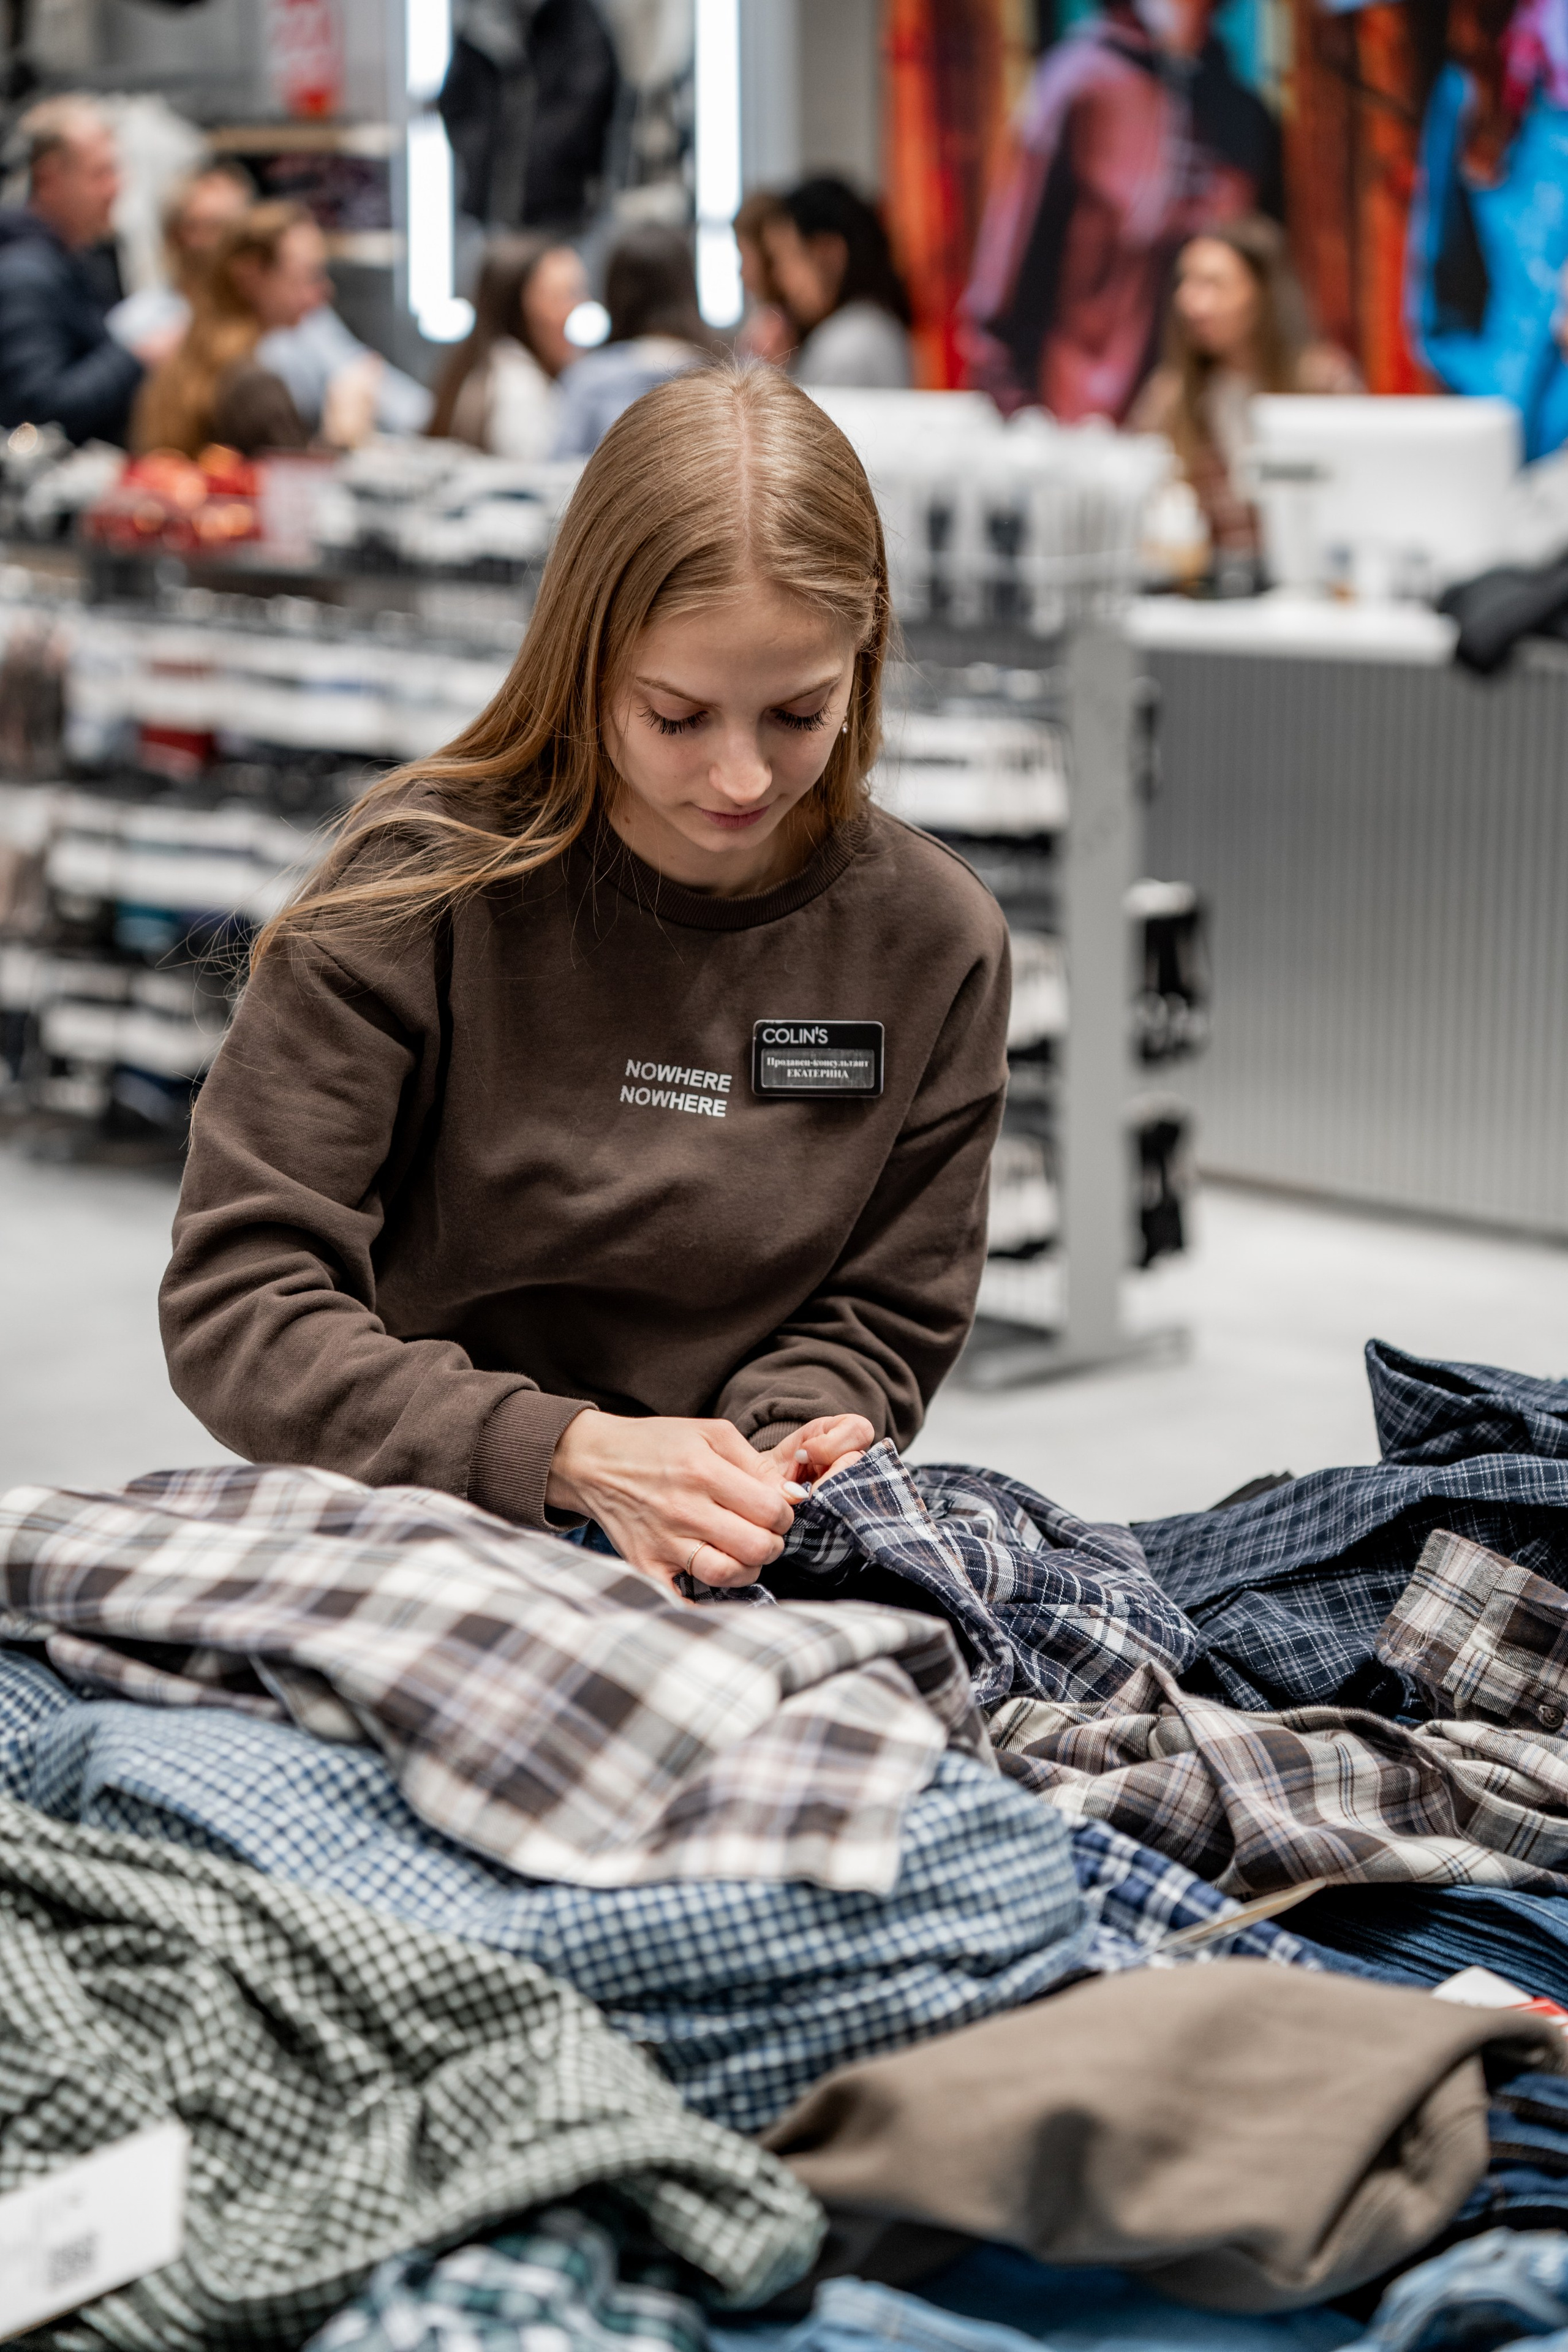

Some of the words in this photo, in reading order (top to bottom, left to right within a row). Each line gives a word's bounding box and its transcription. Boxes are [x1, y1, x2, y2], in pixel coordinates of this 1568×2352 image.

[763, 1027, 828, 1044] COLIN'S
[625, 1059, 732, 1093] NOWHERE
[786, 1068, 849, 1079] ЕКАТЕРИНА
[620, 1085, 727, 1117] NOWHERE
